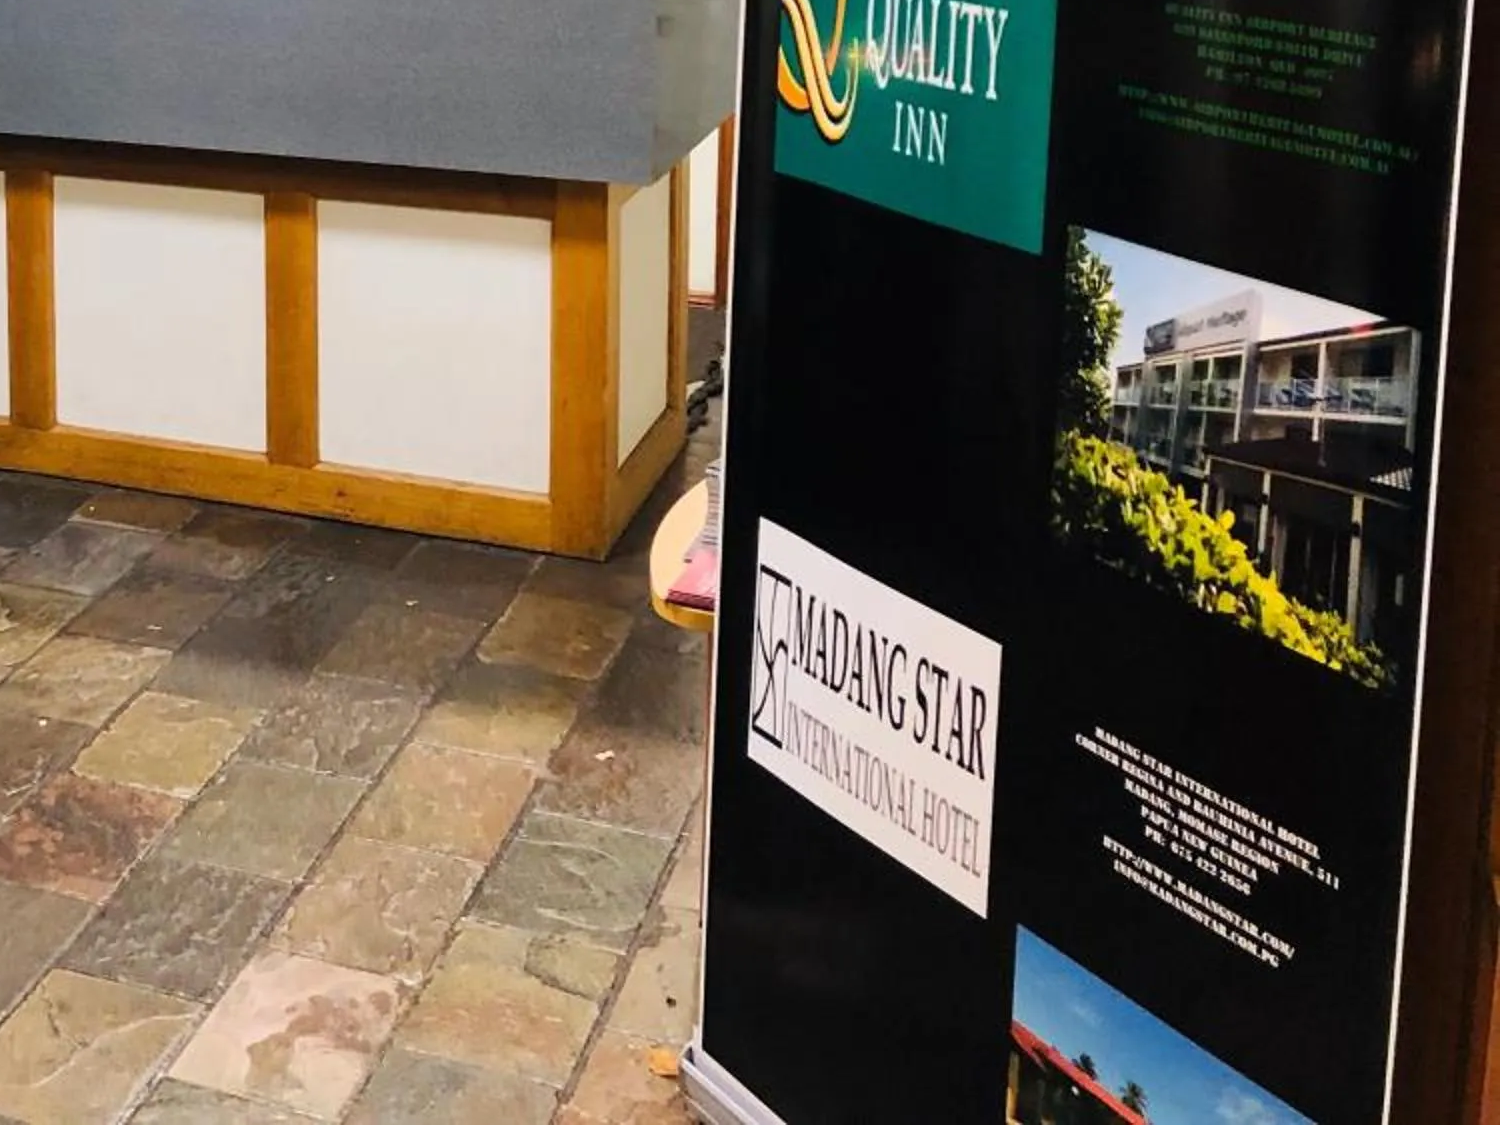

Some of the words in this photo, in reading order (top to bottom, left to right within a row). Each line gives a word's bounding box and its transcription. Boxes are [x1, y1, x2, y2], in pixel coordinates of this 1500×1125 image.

[892, 101, 949, 166] INN
[791, 586, 907, 731] MADANG
[912, 656, 987, 780] STAR
[784, 700, 918, 836] INTERNATIONAL
[920, 788, 982, 878] HOTEL
[1095, 726, 1141, 761] MADANG
[1142, 754, 1172, 779] STAR
[1175, 771, 1275, 834] INTERNATIONAL
[1278, 826, 1320, 859] HOTEL
[1166, 785, 1191, 806] AND
[1141, 804, 1179, 837] PAPUA
[1182, 829, 1208, 851] NEW
[1210, 846, 1258, 881] GUINEA
[1231, 838, 1279, 874] REGION
